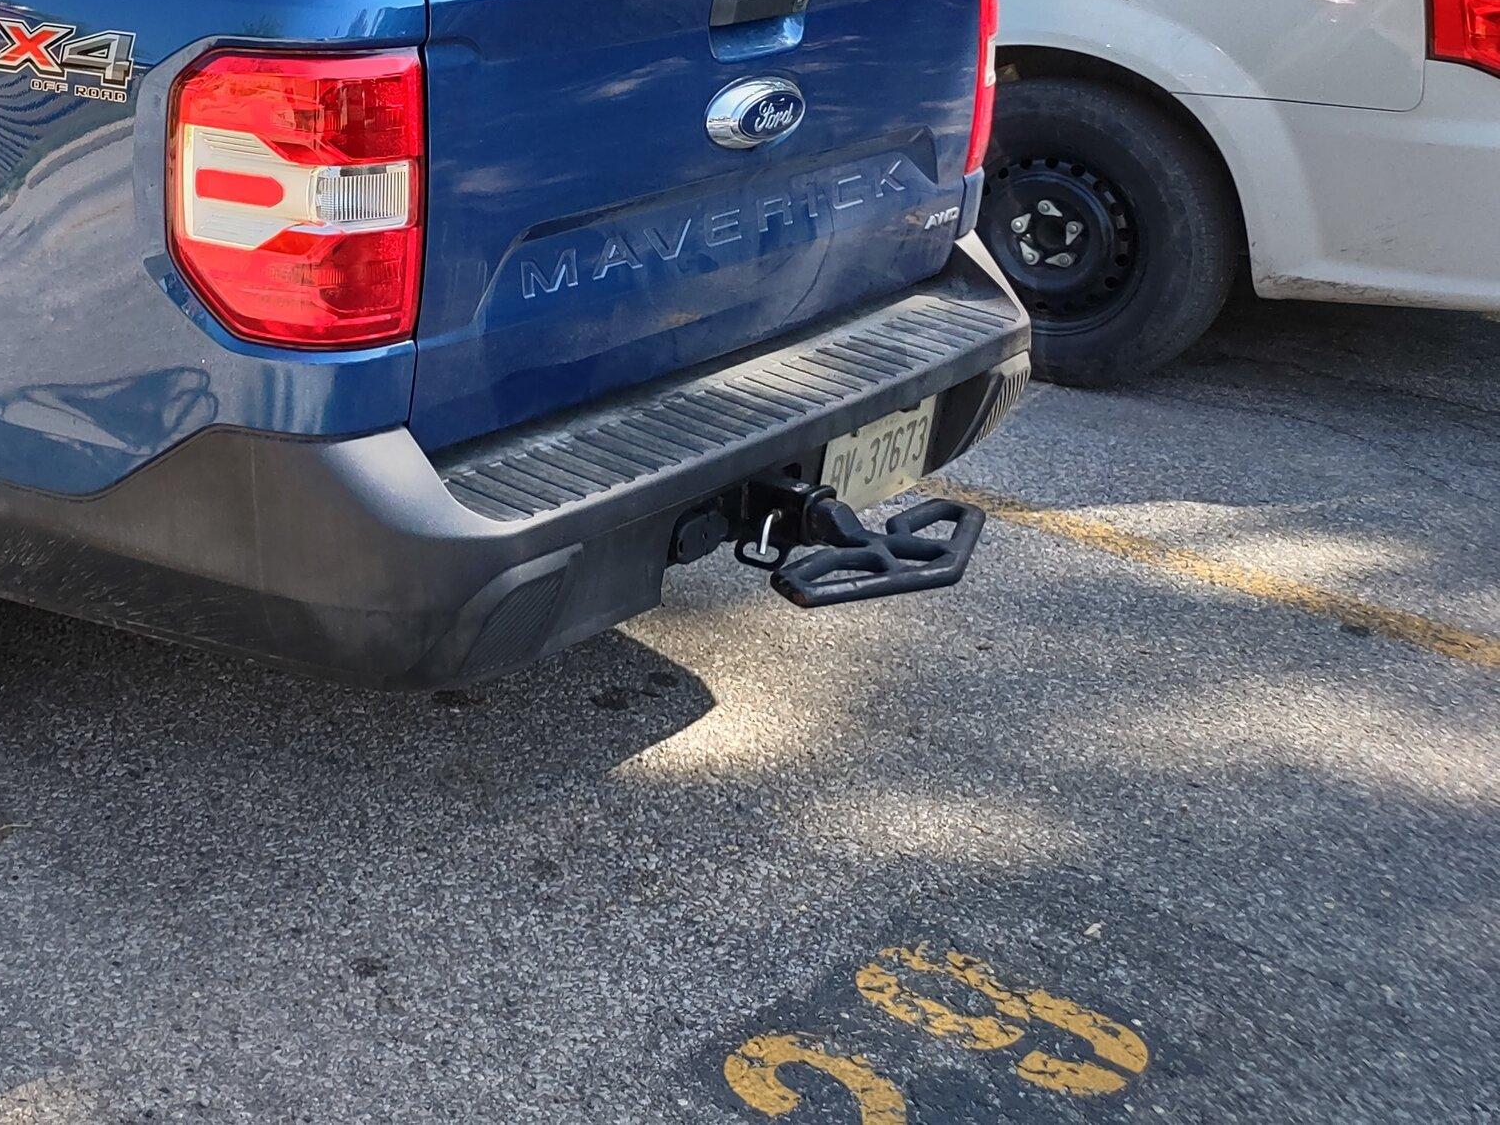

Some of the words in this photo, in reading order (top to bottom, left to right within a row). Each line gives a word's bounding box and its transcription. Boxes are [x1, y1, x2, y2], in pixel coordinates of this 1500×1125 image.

[30, 79, 68, 92] OFF
[74, 84, 127, 103] ROAD
[754, 97, 794, 132] Ford
[520, 159, 906, 299] MAVERICK
[924, 206, 959, 230] AWD
[864, 415, 928, 485] 37673
